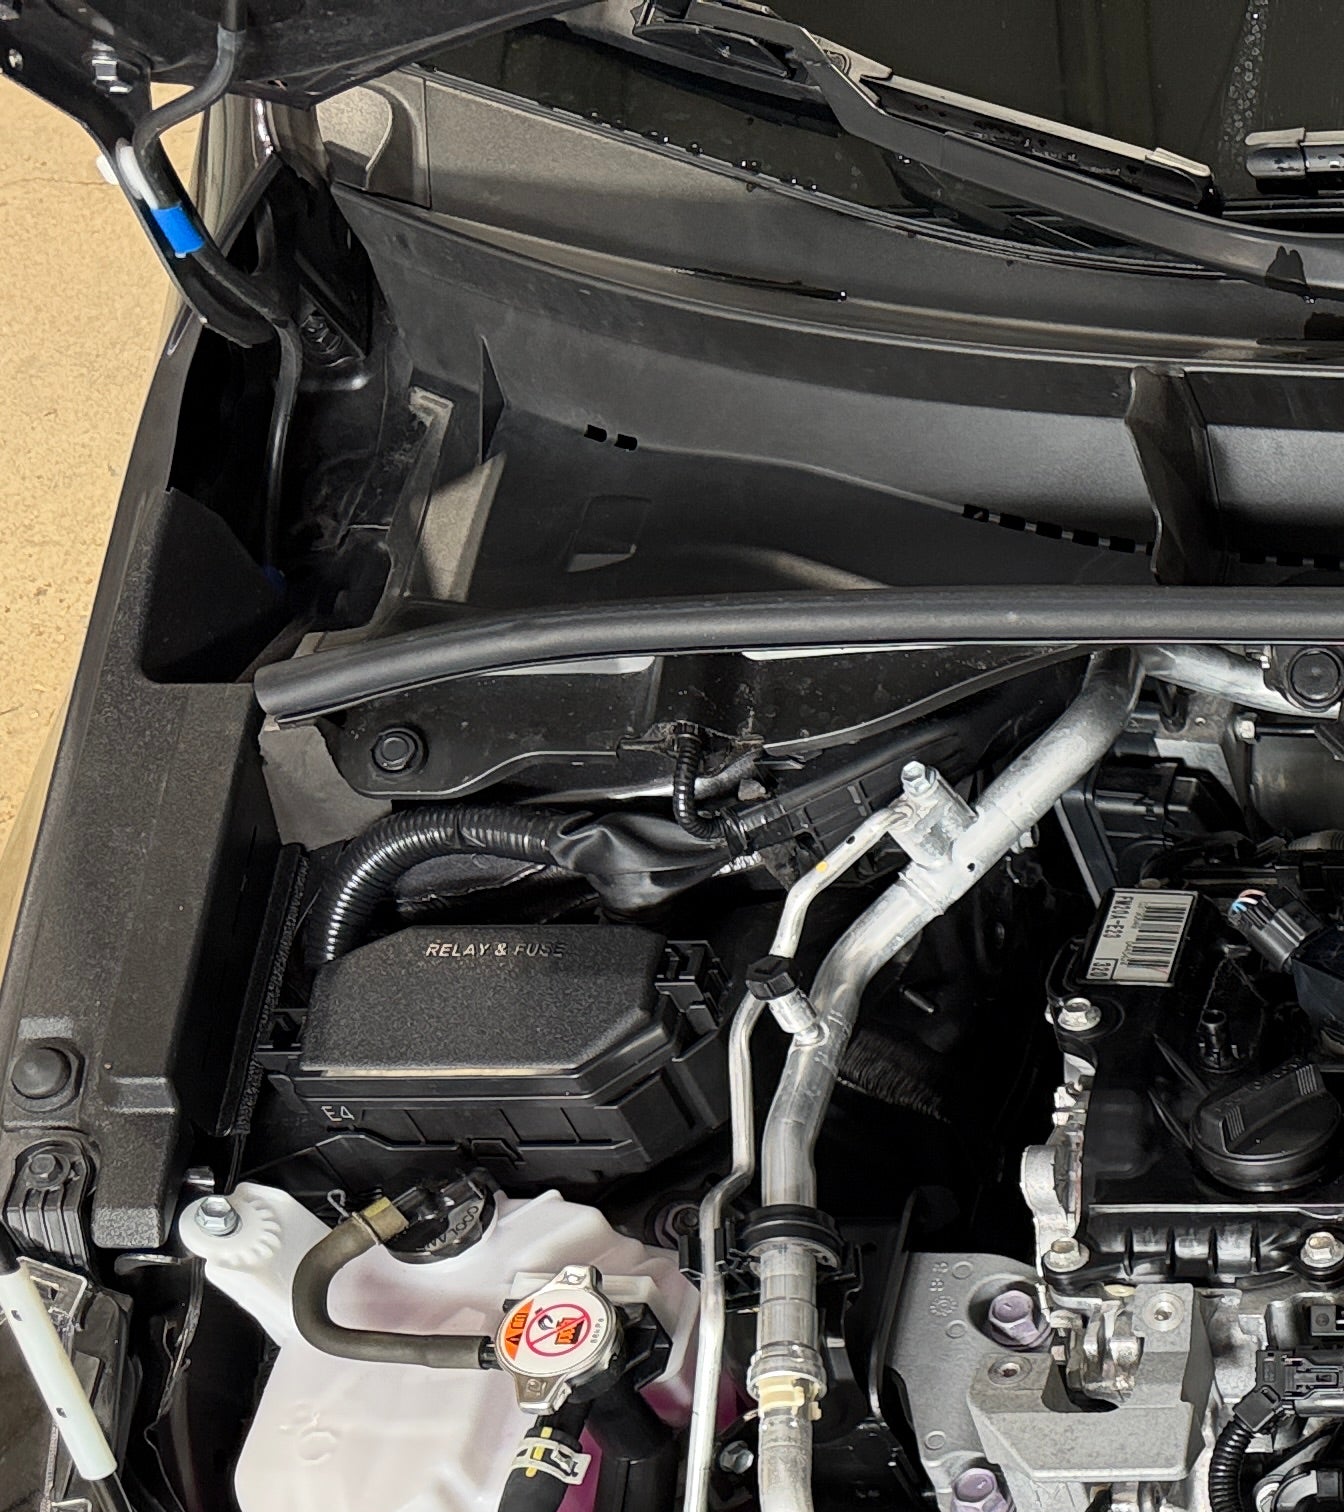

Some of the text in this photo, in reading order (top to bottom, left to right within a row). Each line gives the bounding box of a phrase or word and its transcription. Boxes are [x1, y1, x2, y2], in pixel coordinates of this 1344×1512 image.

[425, 942, 567, 957] RELAY & FUSE
[320, 1105, 355, 1122] E4
